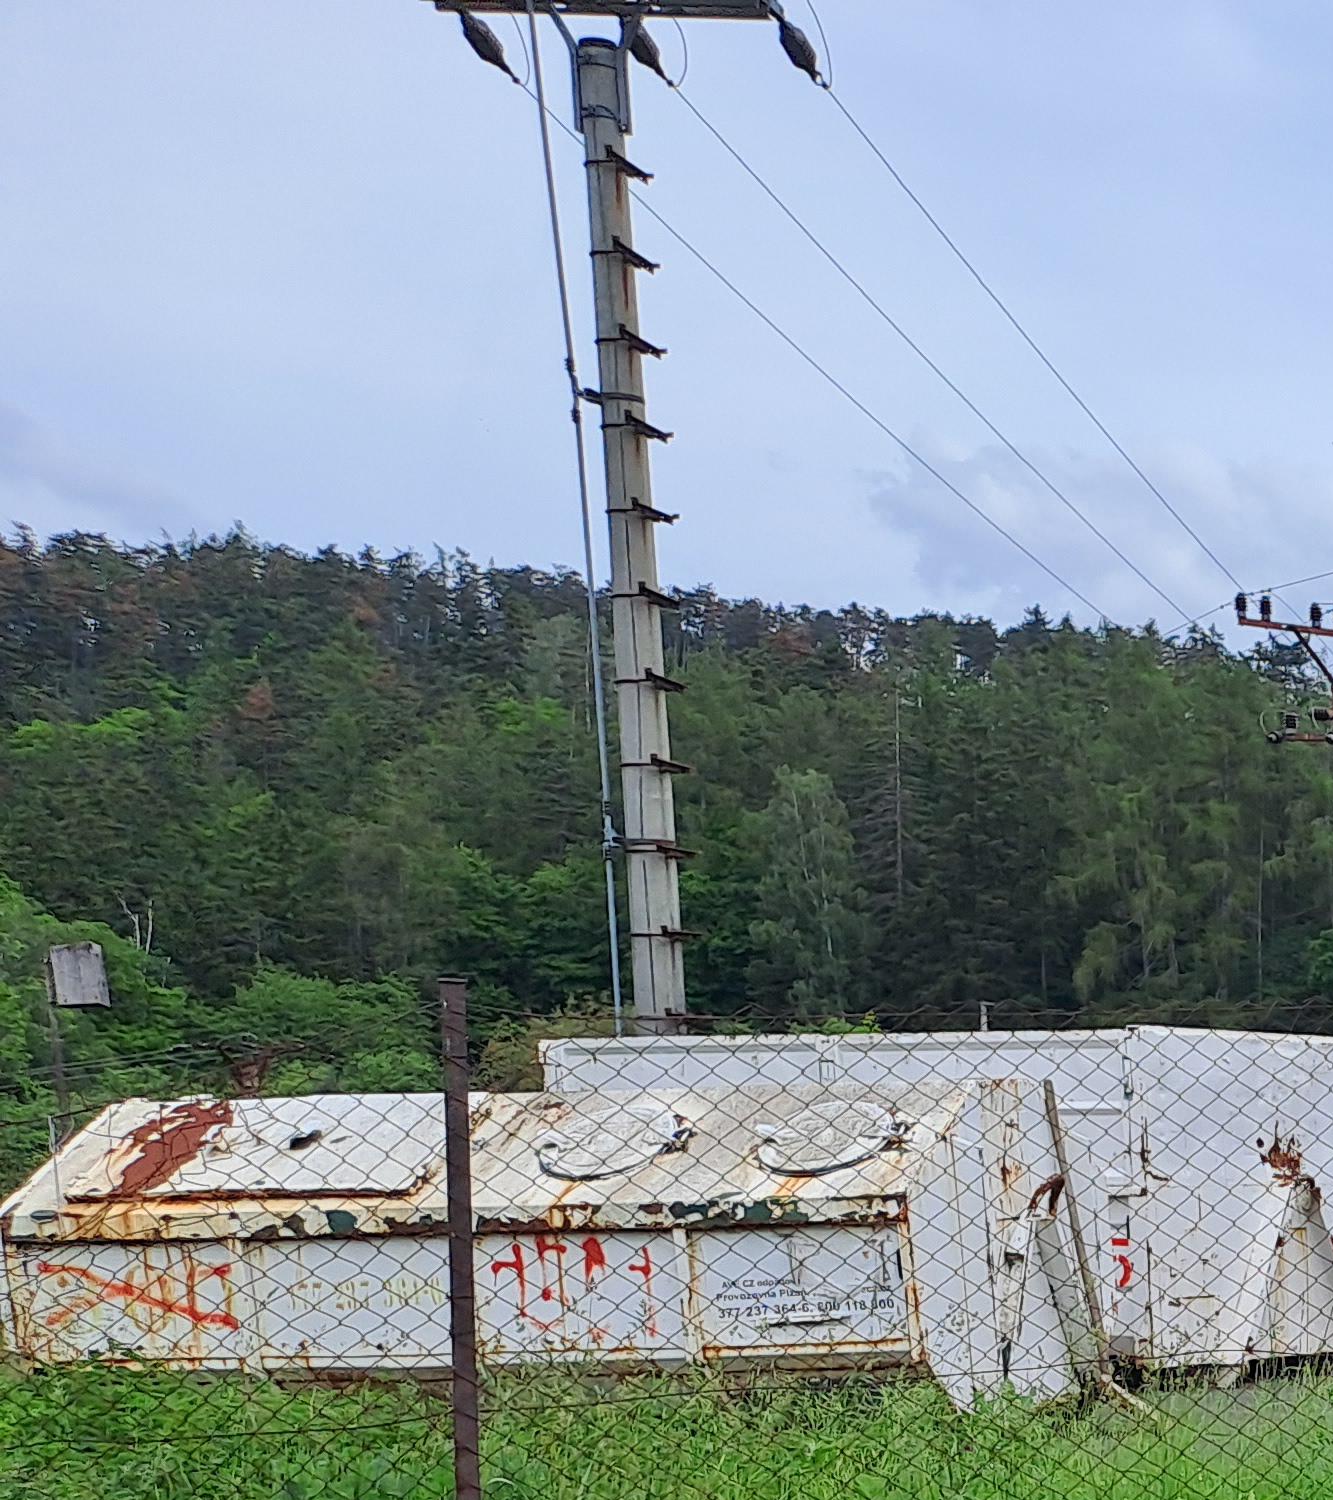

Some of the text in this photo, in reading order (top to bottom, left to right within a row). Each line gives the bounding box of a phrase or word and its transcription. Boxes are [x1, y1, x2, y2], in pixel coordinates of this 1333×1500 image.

[742, 1279, 755, 1287] CZ
[716, 1291, 777, 1301] Provozovna
[746, 1304, 769, 1317] 237
[846, 1299, 867, 1310] 118
